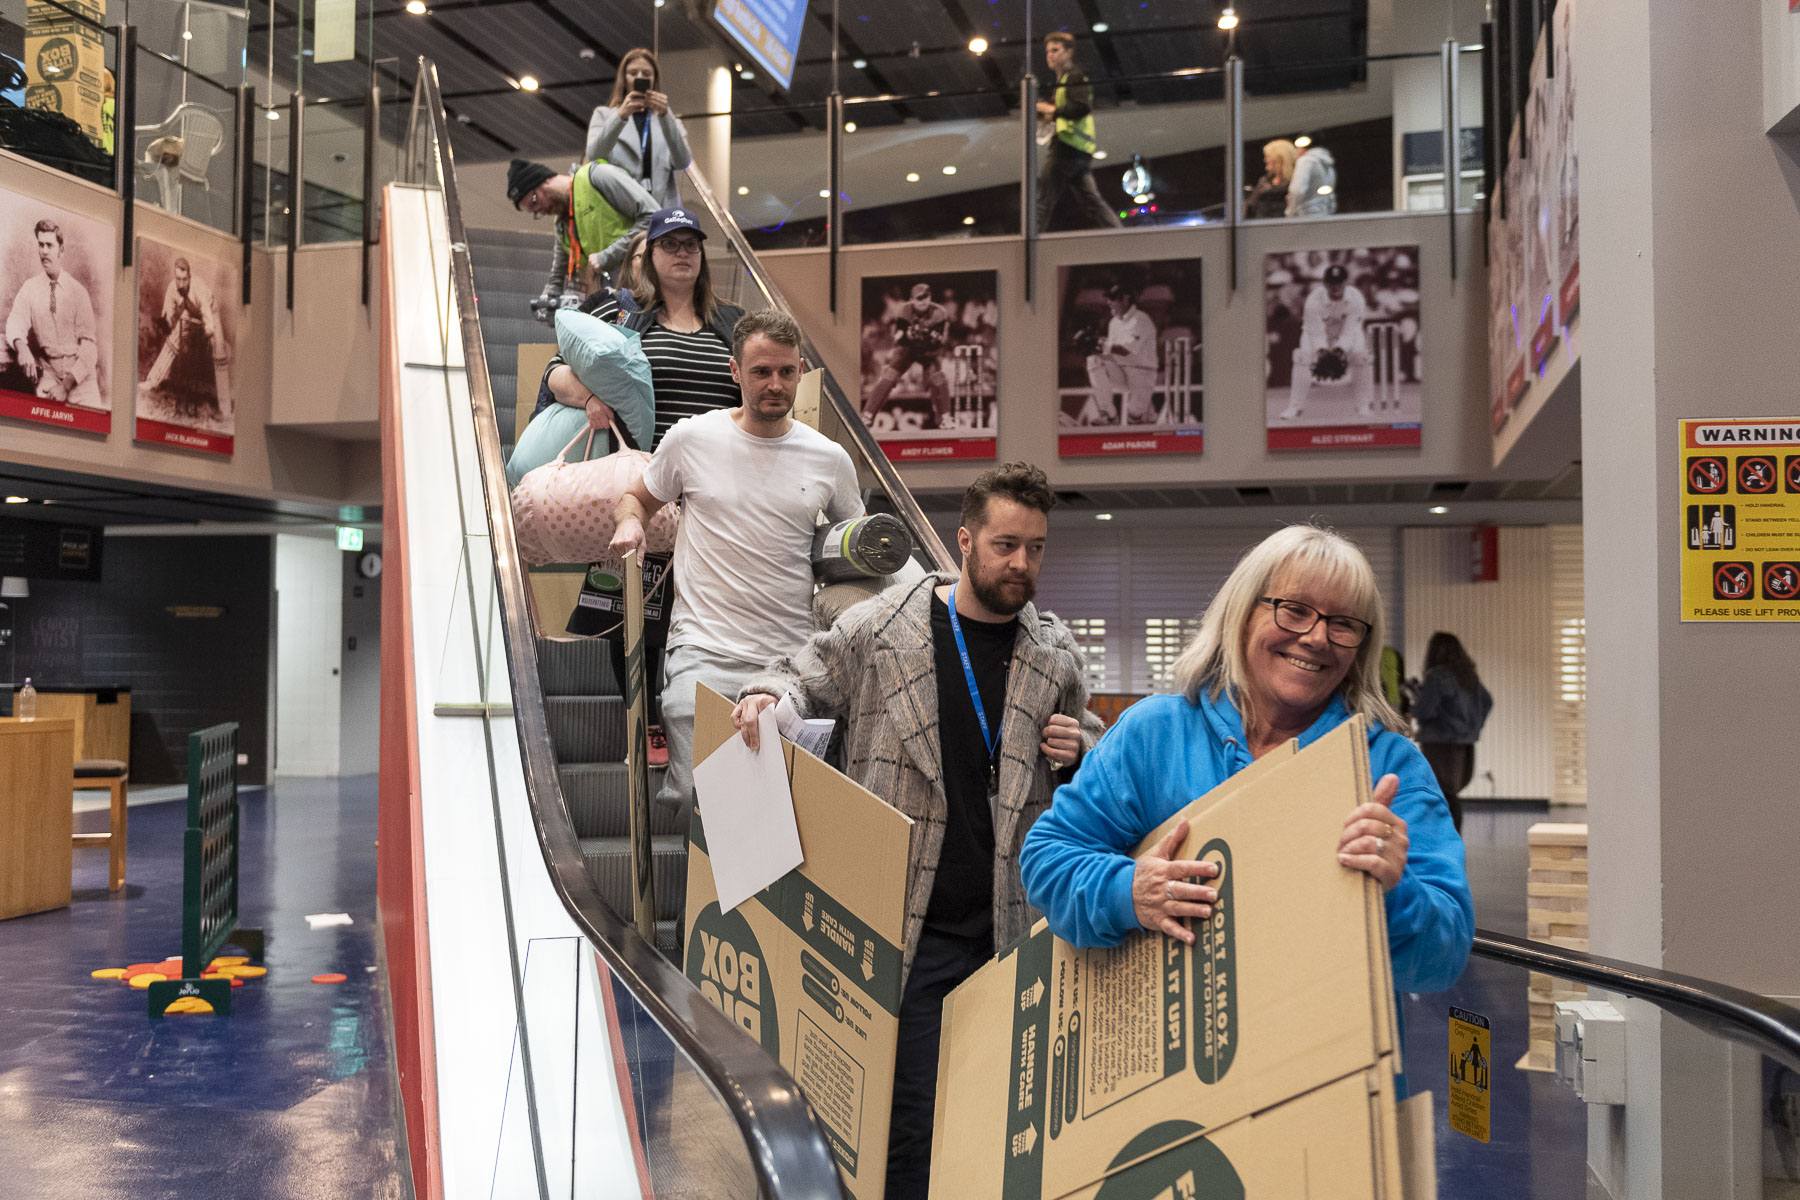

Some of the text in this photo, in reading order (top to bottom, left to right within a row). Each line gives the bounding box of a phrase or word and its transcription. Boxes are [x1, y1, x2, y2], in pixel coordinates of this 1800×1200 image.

[41, 43, 71, 61] BOX
[31, 407, 74, 422] AFFIE JARVIS
[901, 447, 953, 456] ANDY FLOWER
[1102, 441, 1125, 450] ADAM
[1694, 608, 1730, 616] PLEASE
[1733, 608, 1752, 616] USE
[1755, 608, 1774, 616] LIFT
[951, 614, 961, 634] STAFF
[961, 651, 971, 671] STAFF
[978, 711, 988, 730] STAFF
[805, 891, 815, 904] UP
[821, 909, 855, 944] WITH CARE
[820, 919, 855, 958] HANDLE
[864, 939, 875, 953] UP
[700, 929, 760, 1006] BOX
[1214, 897, 1229, 1047] FORT KNOX
[1202, 920, 1213, 1059] ELF STORAGE
[850, 996, 872, 1021] FOLLOW
[1021, 990, 1026, 1012] UP
[1168, 969, 1181, 1052] IT UP!
[1453, 1008, 1485, 1028] CAUTION
[855, 1024, 868, 1041] LIKE
[1455, 1021, 1481, 1036] Passengers
[1455, 1029, 1465, 1039] Only
[1025, 1024, 1036, 1109] HANDLE
[1018, 1071, 1026, 1112] CARE
[1012, 1134, 1018, 1157] UP
